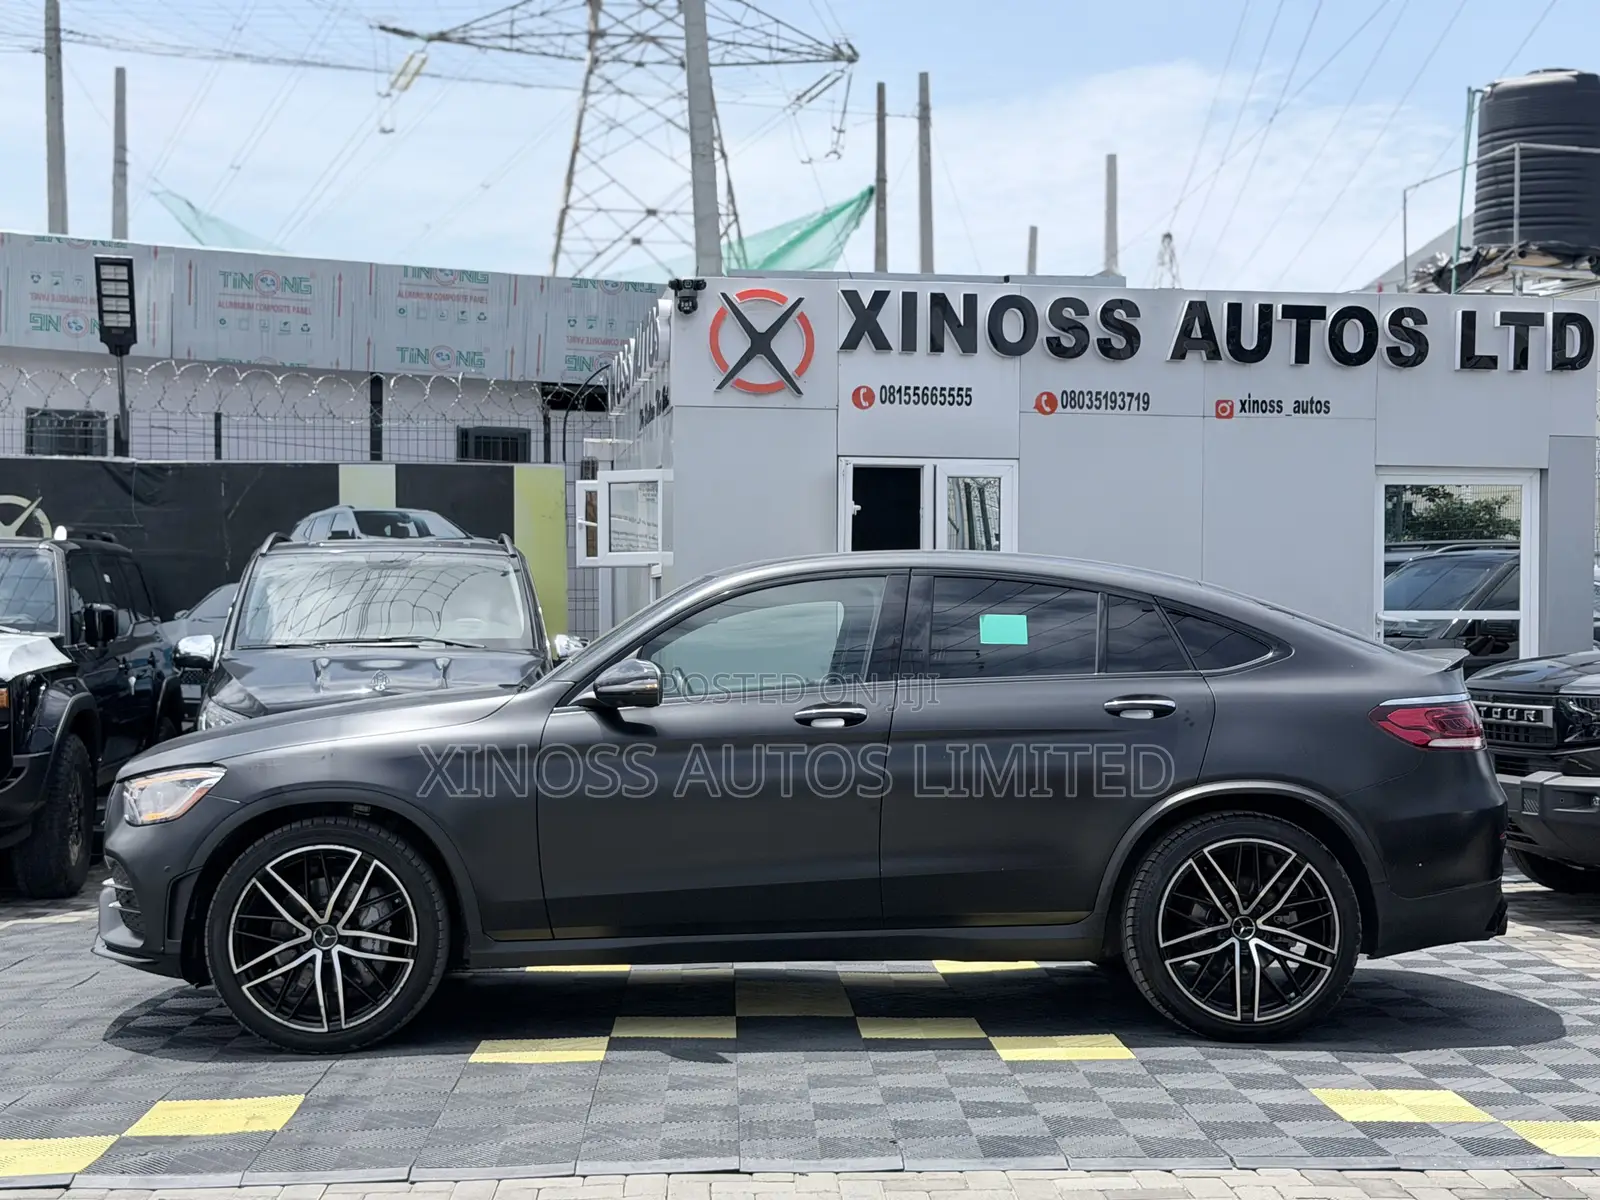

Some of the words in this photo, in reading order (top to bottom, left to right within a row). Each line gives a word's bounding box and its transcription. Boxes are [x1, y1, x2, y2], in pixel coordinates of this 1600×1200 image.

[837, 289, 1142, 362] XINOSS
[1165, 299, 1431, 369] AUTOS
[1454, 309, 1595, 372] LTD
[879, 384, 973, 406] 08155665555
[1060, 390, 1150, 412] 08035193719
[1239, 392, 1331, 417] xinoss_autos
[1478, 706, 1536, 721] TOUR
